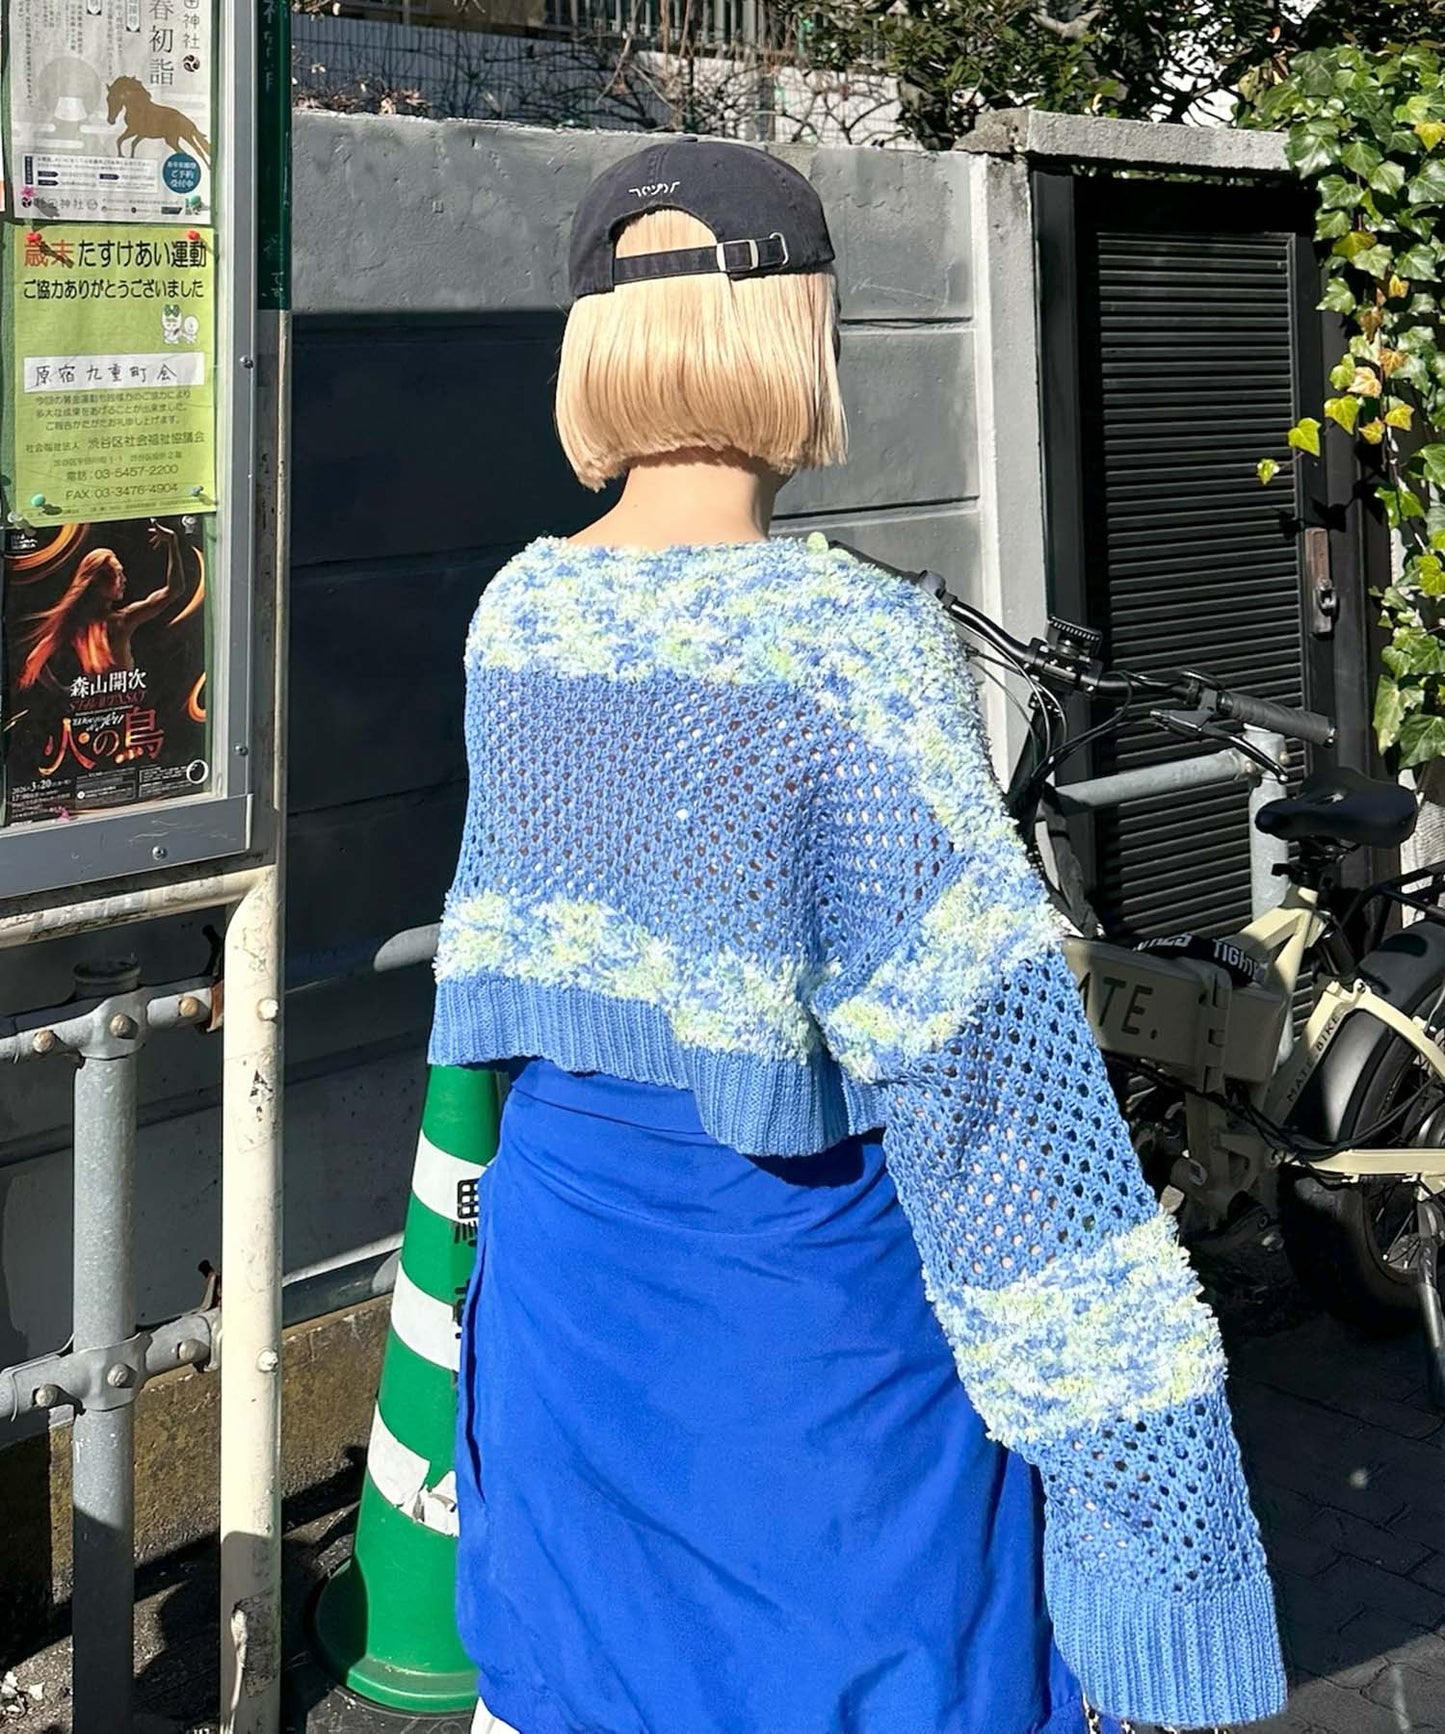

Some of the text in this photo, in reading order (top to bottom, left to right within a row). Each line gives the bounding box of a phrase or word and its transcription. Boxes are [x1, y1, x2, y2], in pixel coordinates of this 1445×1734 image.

[24, 279, 204, 299] ご協力ありがとうございました
[70, 668, 147, 698] 森山開次
[39, 706, 165, 775] 火の鳥
